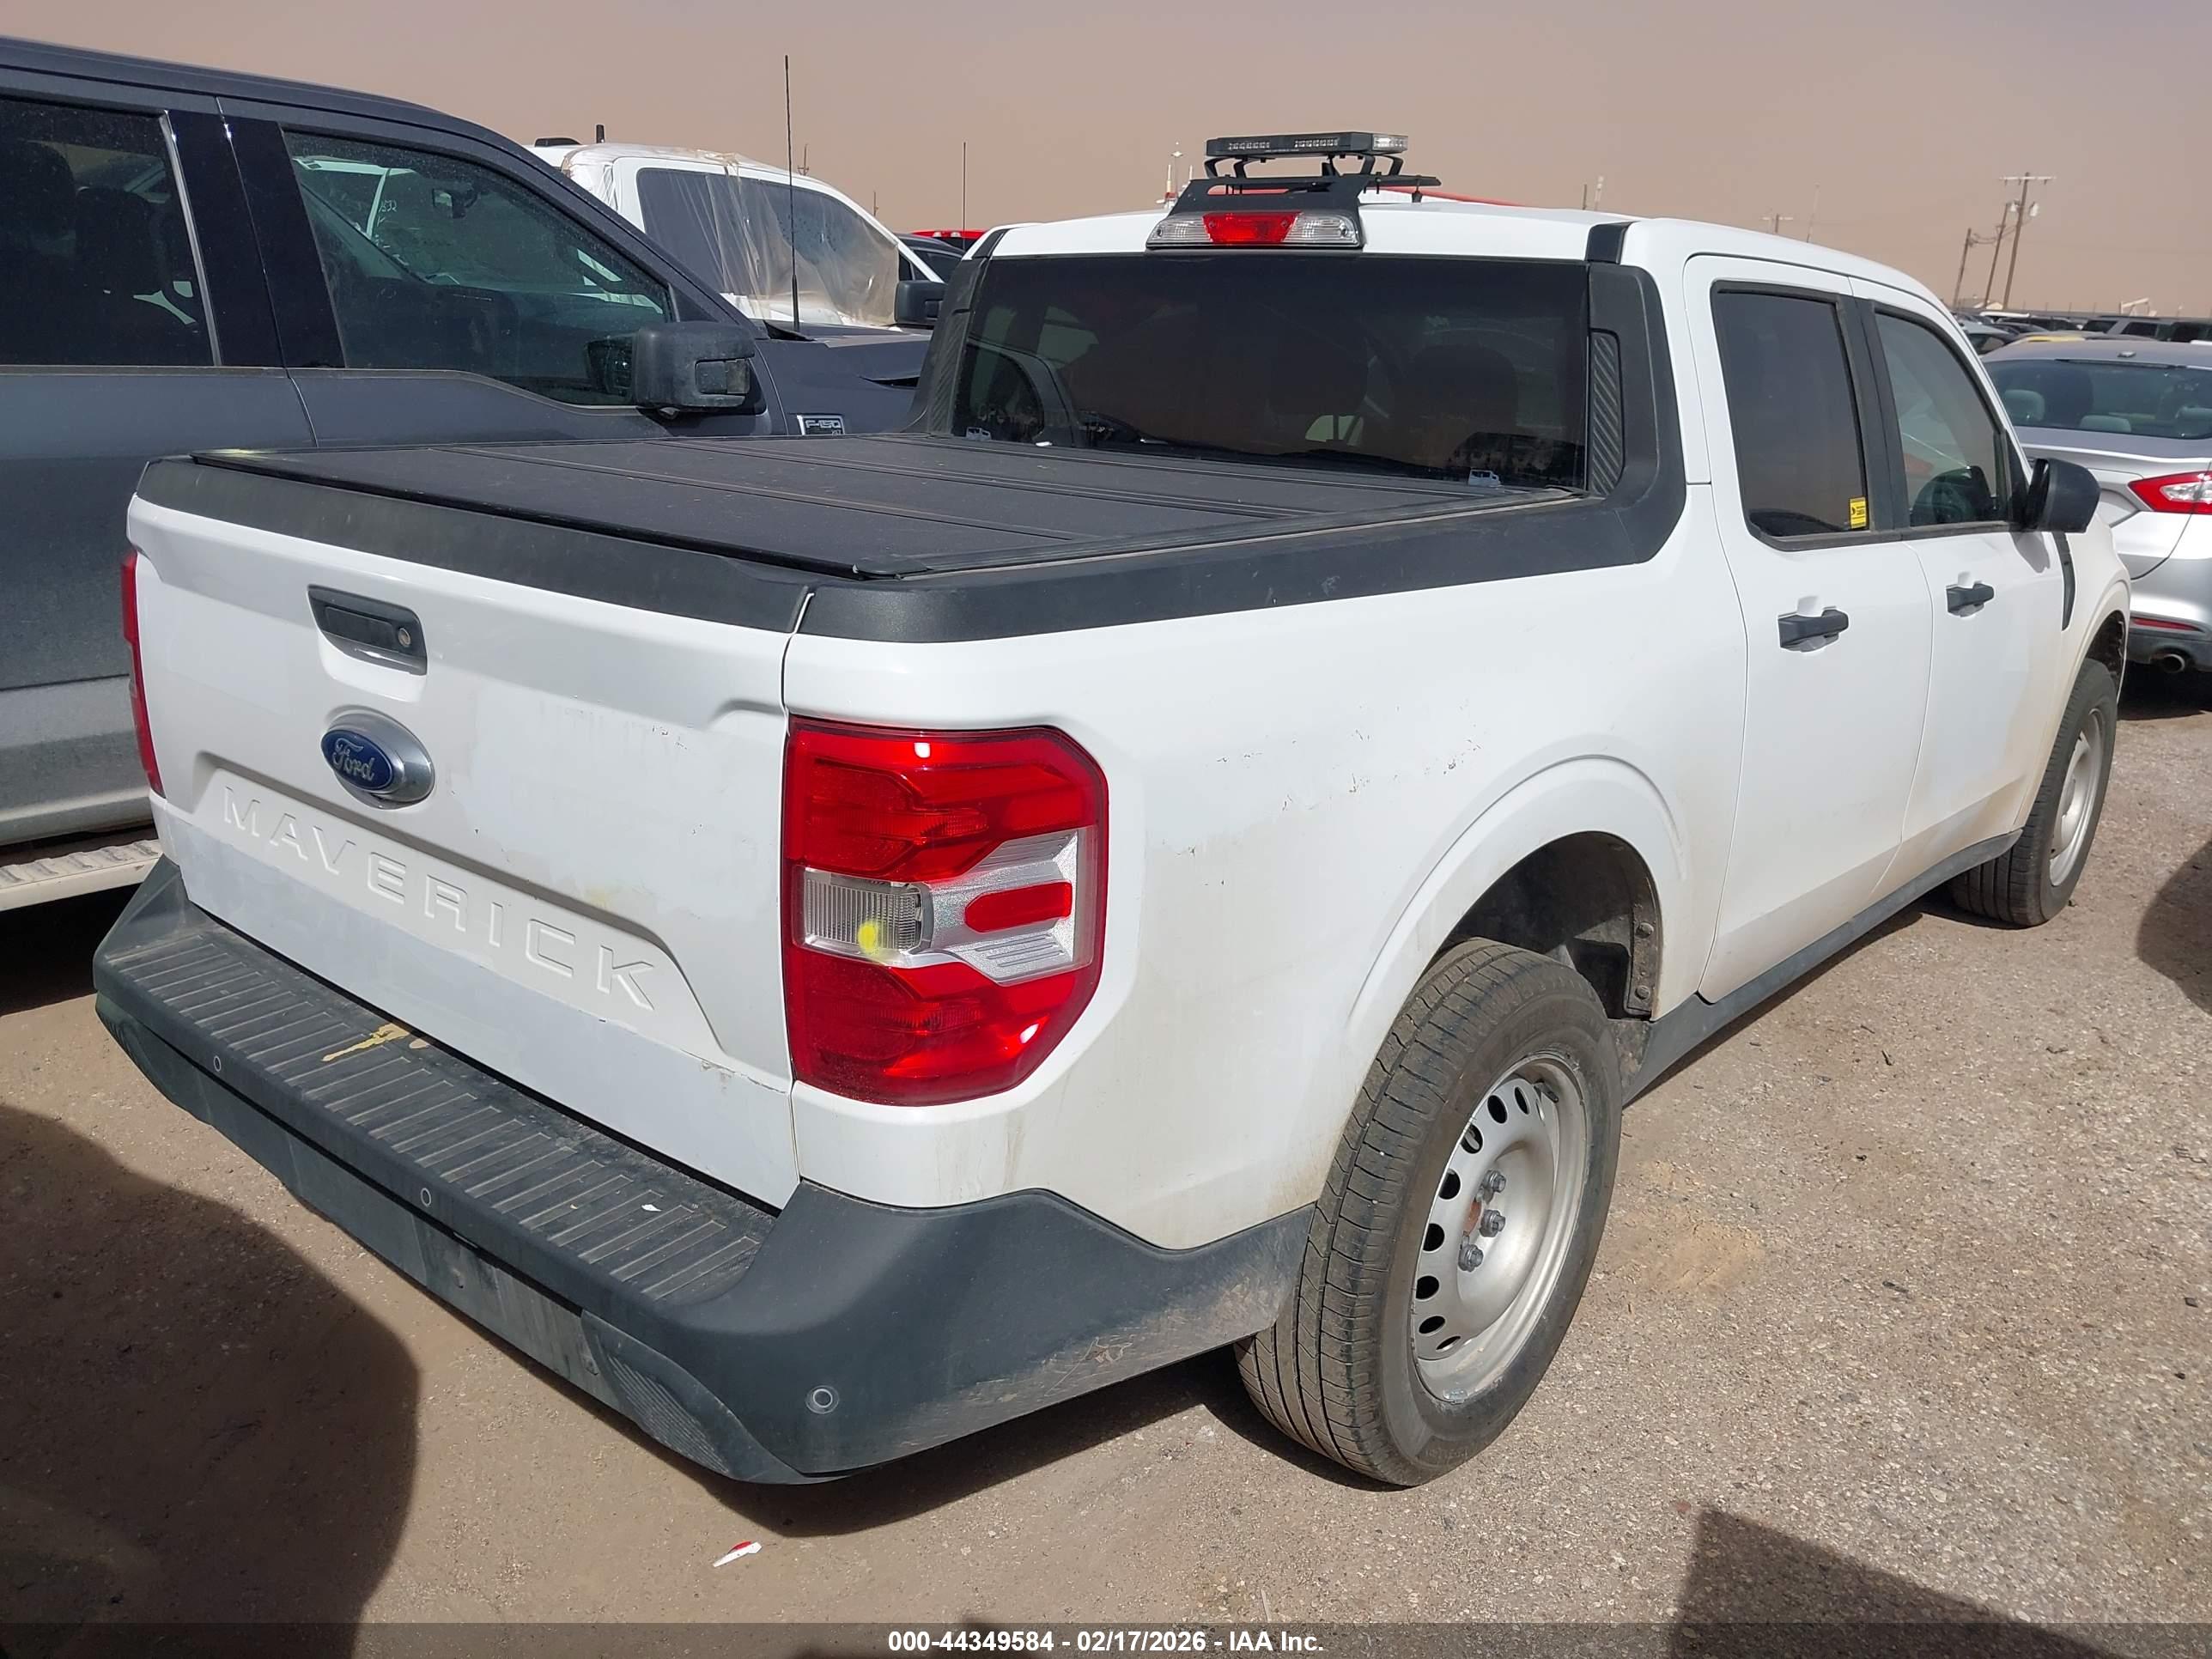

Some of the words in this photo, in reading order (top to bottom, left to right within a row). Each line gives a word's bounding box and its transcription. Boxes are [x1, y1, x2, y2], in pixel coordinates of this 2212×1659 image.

[805, 419, 842, 428] F-150
[332, 737, 375, 782] Ford
[223, 786, 655, 1011] MAVERICK
